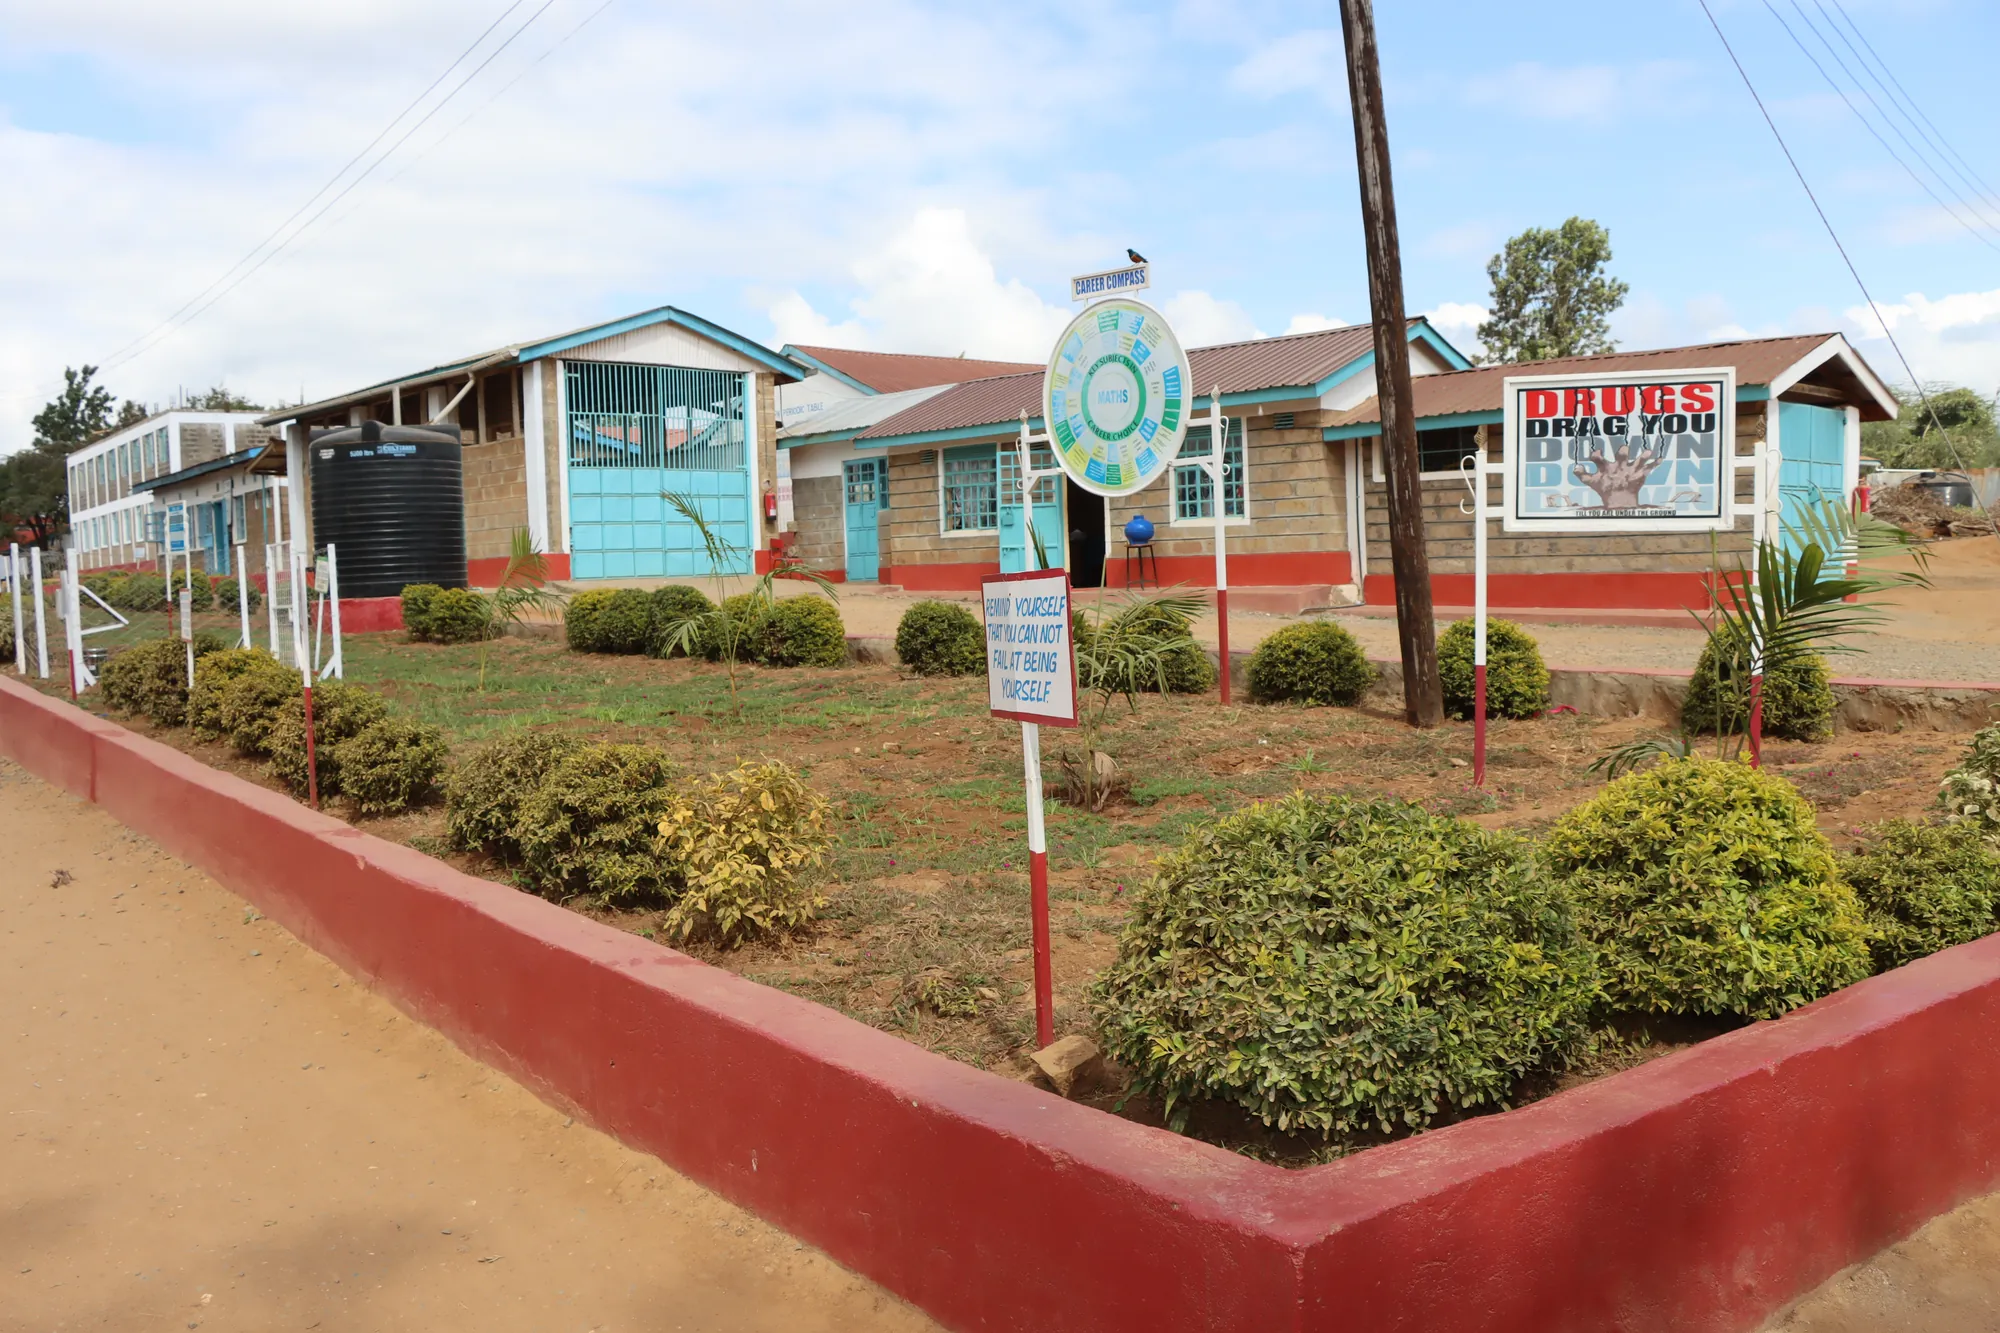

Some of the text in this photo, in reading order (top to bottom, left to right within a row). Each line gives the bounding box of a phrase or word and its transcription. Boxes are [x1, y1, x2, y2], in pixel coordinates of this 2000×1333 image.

[1075, 269, 1145, 295] CAREER COMPASS
[1088, 364, 1099, 377] KEY
[1099, 353, 1131, 366] SUBJECTS
[1098, 389, 1128, 404] MATHS
[1525, 383, 1715, 418] DRUGS
[1087, 419, 1110, 440] CAREER
[1112, 420, 1139, 440] CHOICE
[1526, 413, 1716, 438] DRAG YOU
[1525, 433, 1714, 463] DOWN
[986, 595, 1066, 617] REMIND YOURSELF
[988, 624, 1063, 644] THAT YOU CAN NOT
[993, 649, 1057, 673] FAIL AT BEING
